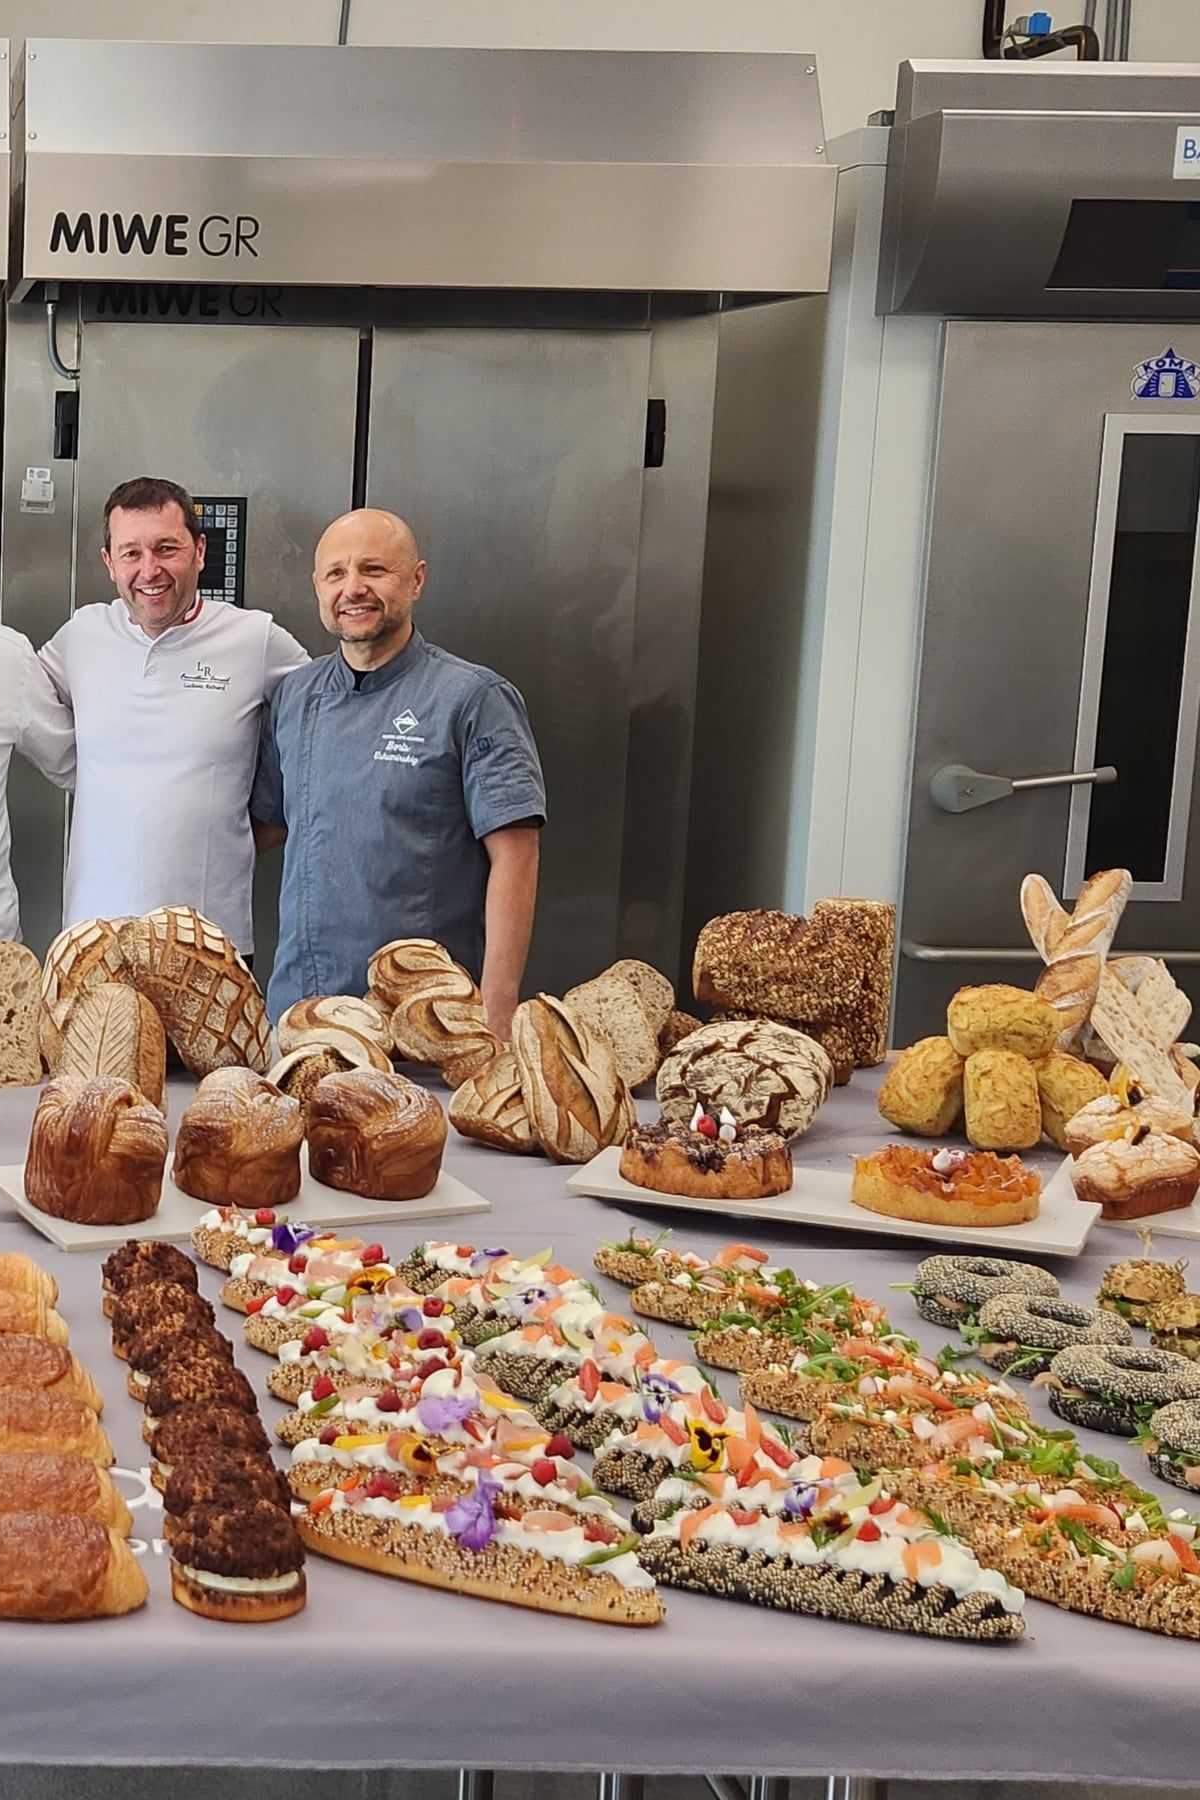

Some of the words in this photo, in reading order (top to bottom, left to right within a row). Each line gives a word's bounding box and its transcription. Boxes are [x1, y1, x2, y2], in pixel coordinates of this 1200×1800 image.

[50, 212, 189, 255] MIWE
[199, 215, 260, 257] GR
[97, 284, 219, 316] MIWE
[1142, 358, 1196, 377] KOMA
